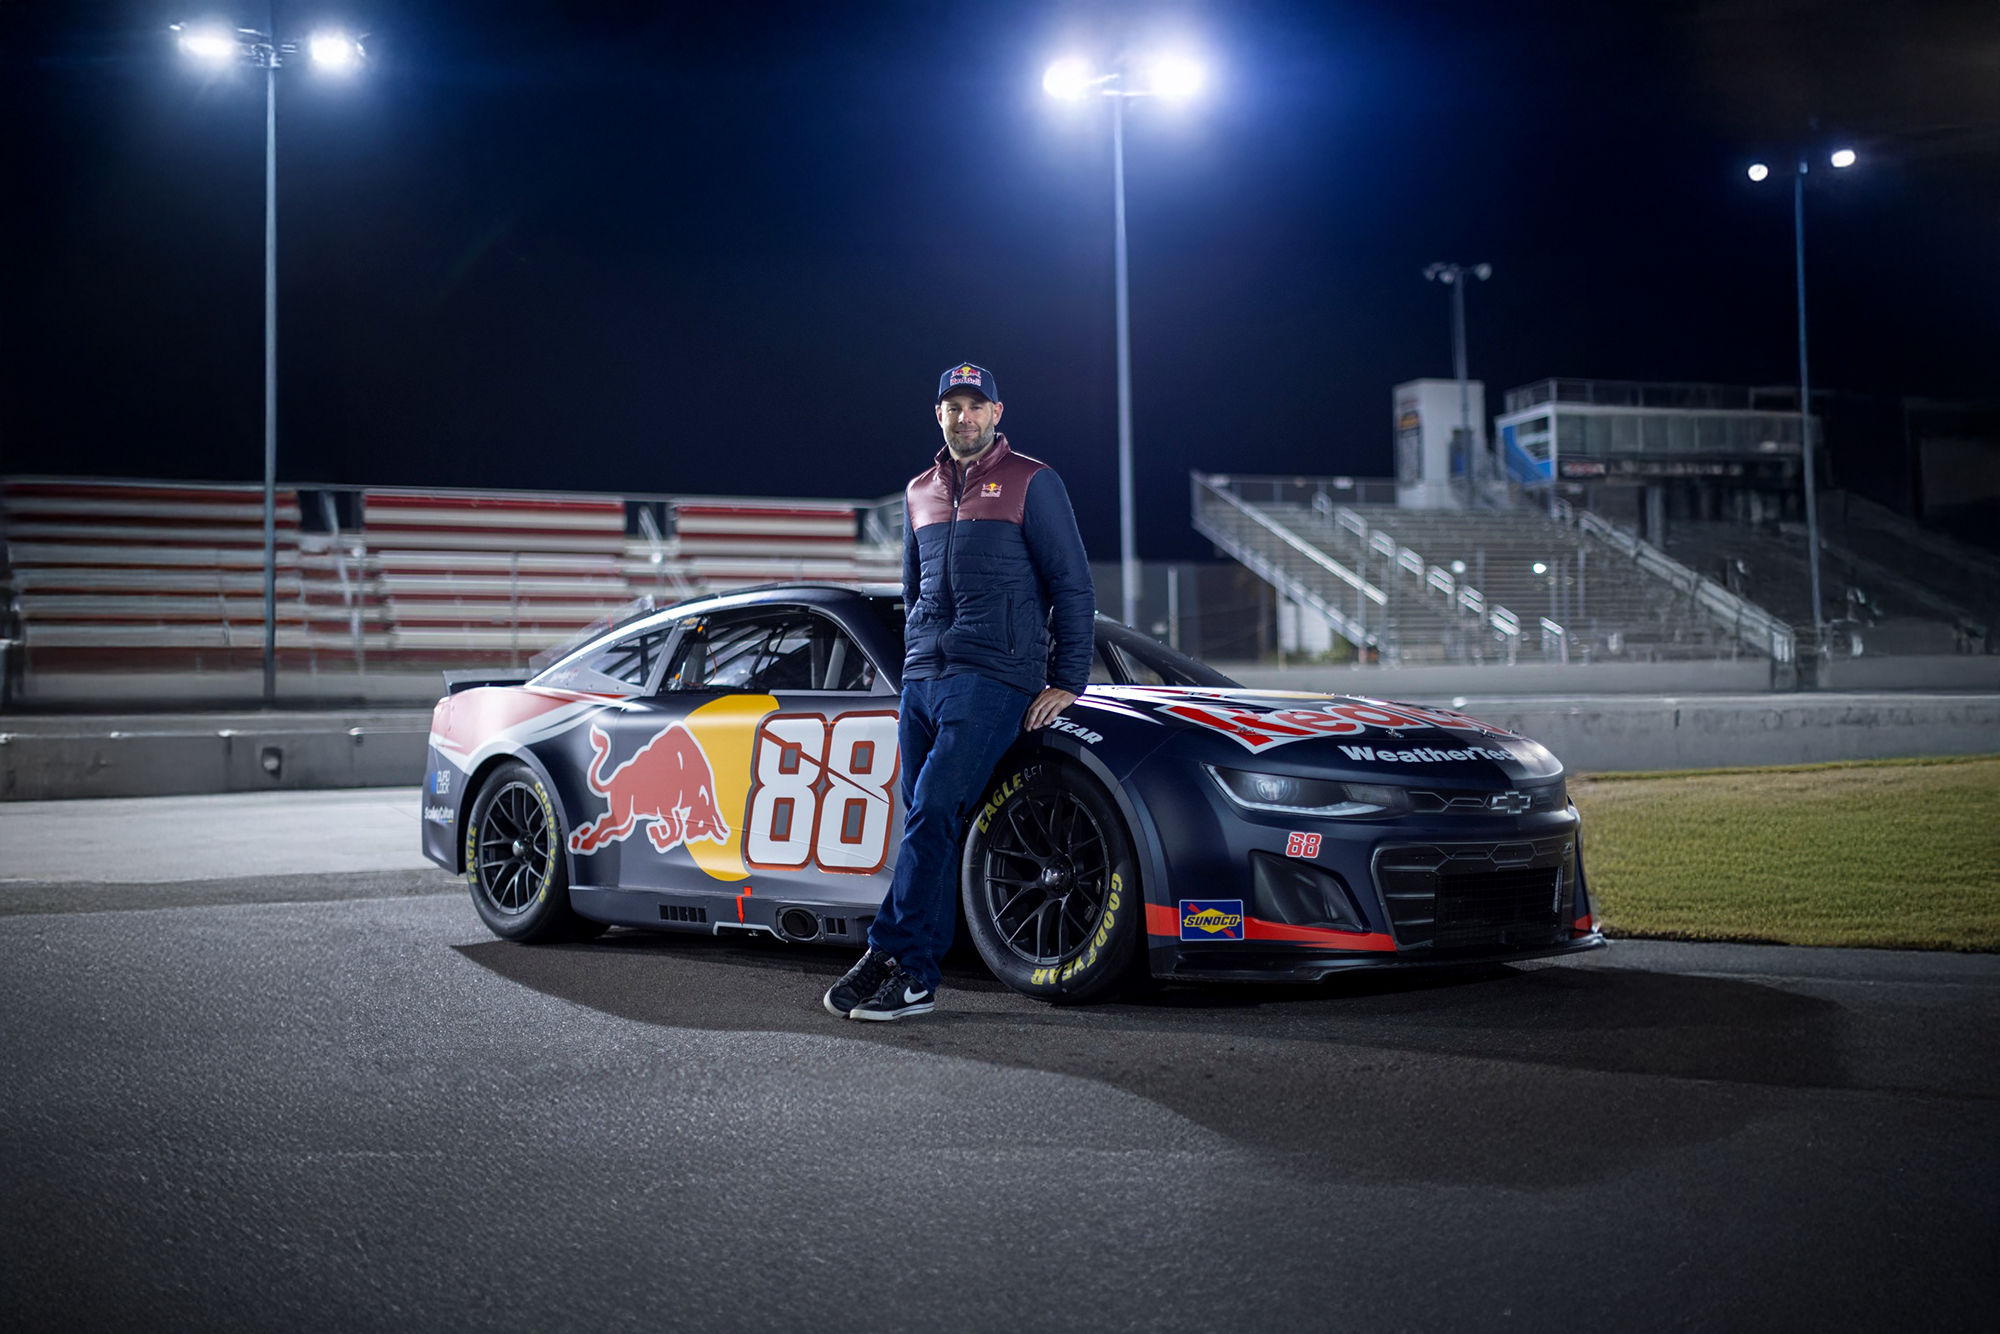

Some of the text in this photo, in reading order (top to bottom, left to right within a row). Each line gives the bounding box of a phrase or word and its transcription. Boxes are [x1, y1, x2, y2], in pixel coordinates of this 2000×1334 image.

[1338, 745, 1527, 763] WeatherTec
[745, 710, 900, 876] 88
[977, 773, 1023, 834] EAGLE
[466, 825, 478, 884] EAGLE
[1286, 831, 1322, 859] 88
[1031, 873, 1122, 985] GOODYEAR
[1185, 915, 1240, 927] SUNOCO
